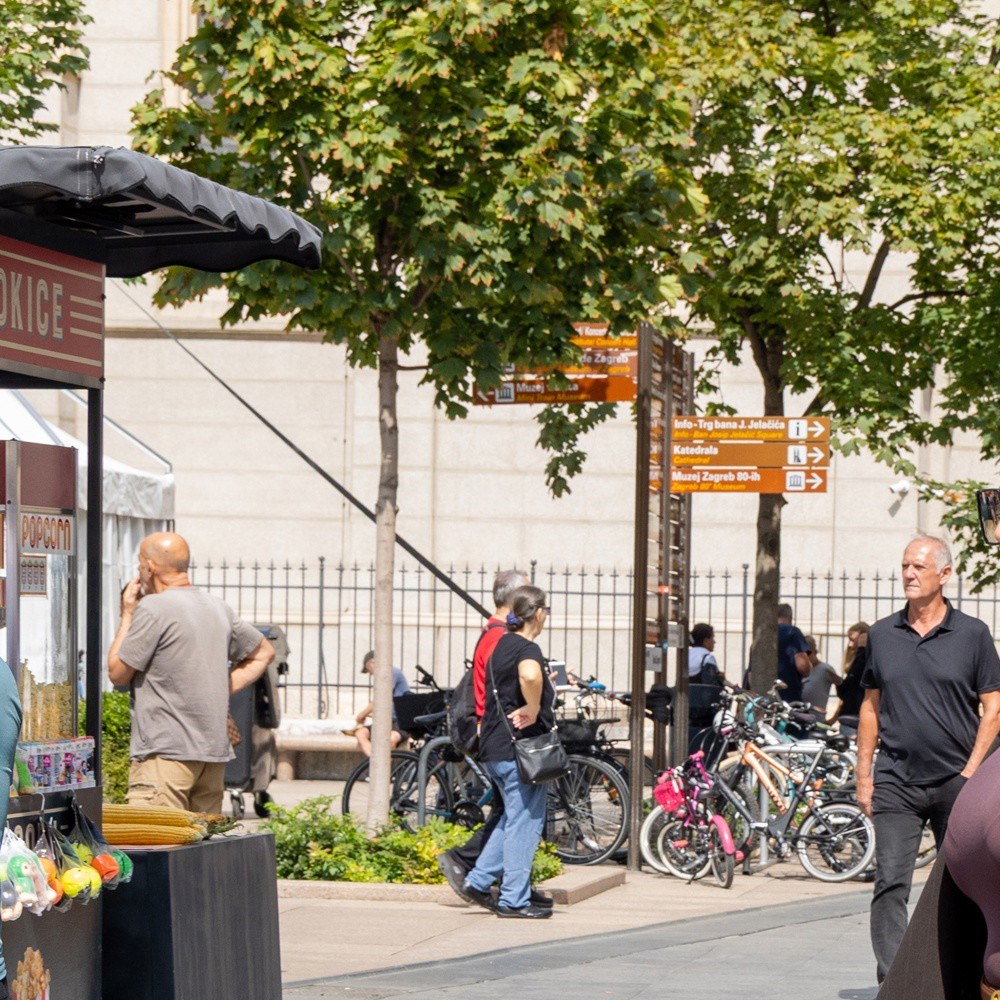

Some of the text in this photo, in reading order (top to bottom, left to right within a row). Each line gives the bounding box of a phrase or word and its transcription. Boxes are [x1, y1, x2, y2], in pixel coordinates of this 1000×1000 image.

[594, 353, 629, 365] Zagreb
[516, 382, 545, 394] Muzej
[674, 419, 693, 429] Info
[697, 419, 713, 431] Trg
[714, 419, 737, 429] bana
[738, 419, 747, 429] J.
[748, 418, 785, 429] Jelačića
[673, 445, 718, 455] Katedrala
[673, 456, 710, 464] Cathedral
[671, 471, 700, 483] Muzej
[702, 471, 735, 483] Zagreb
[736, 471, 760, 481] 80-ih
[671, 482, 699, 491] Zagreb
[713, 482, 746, 490] Museum
